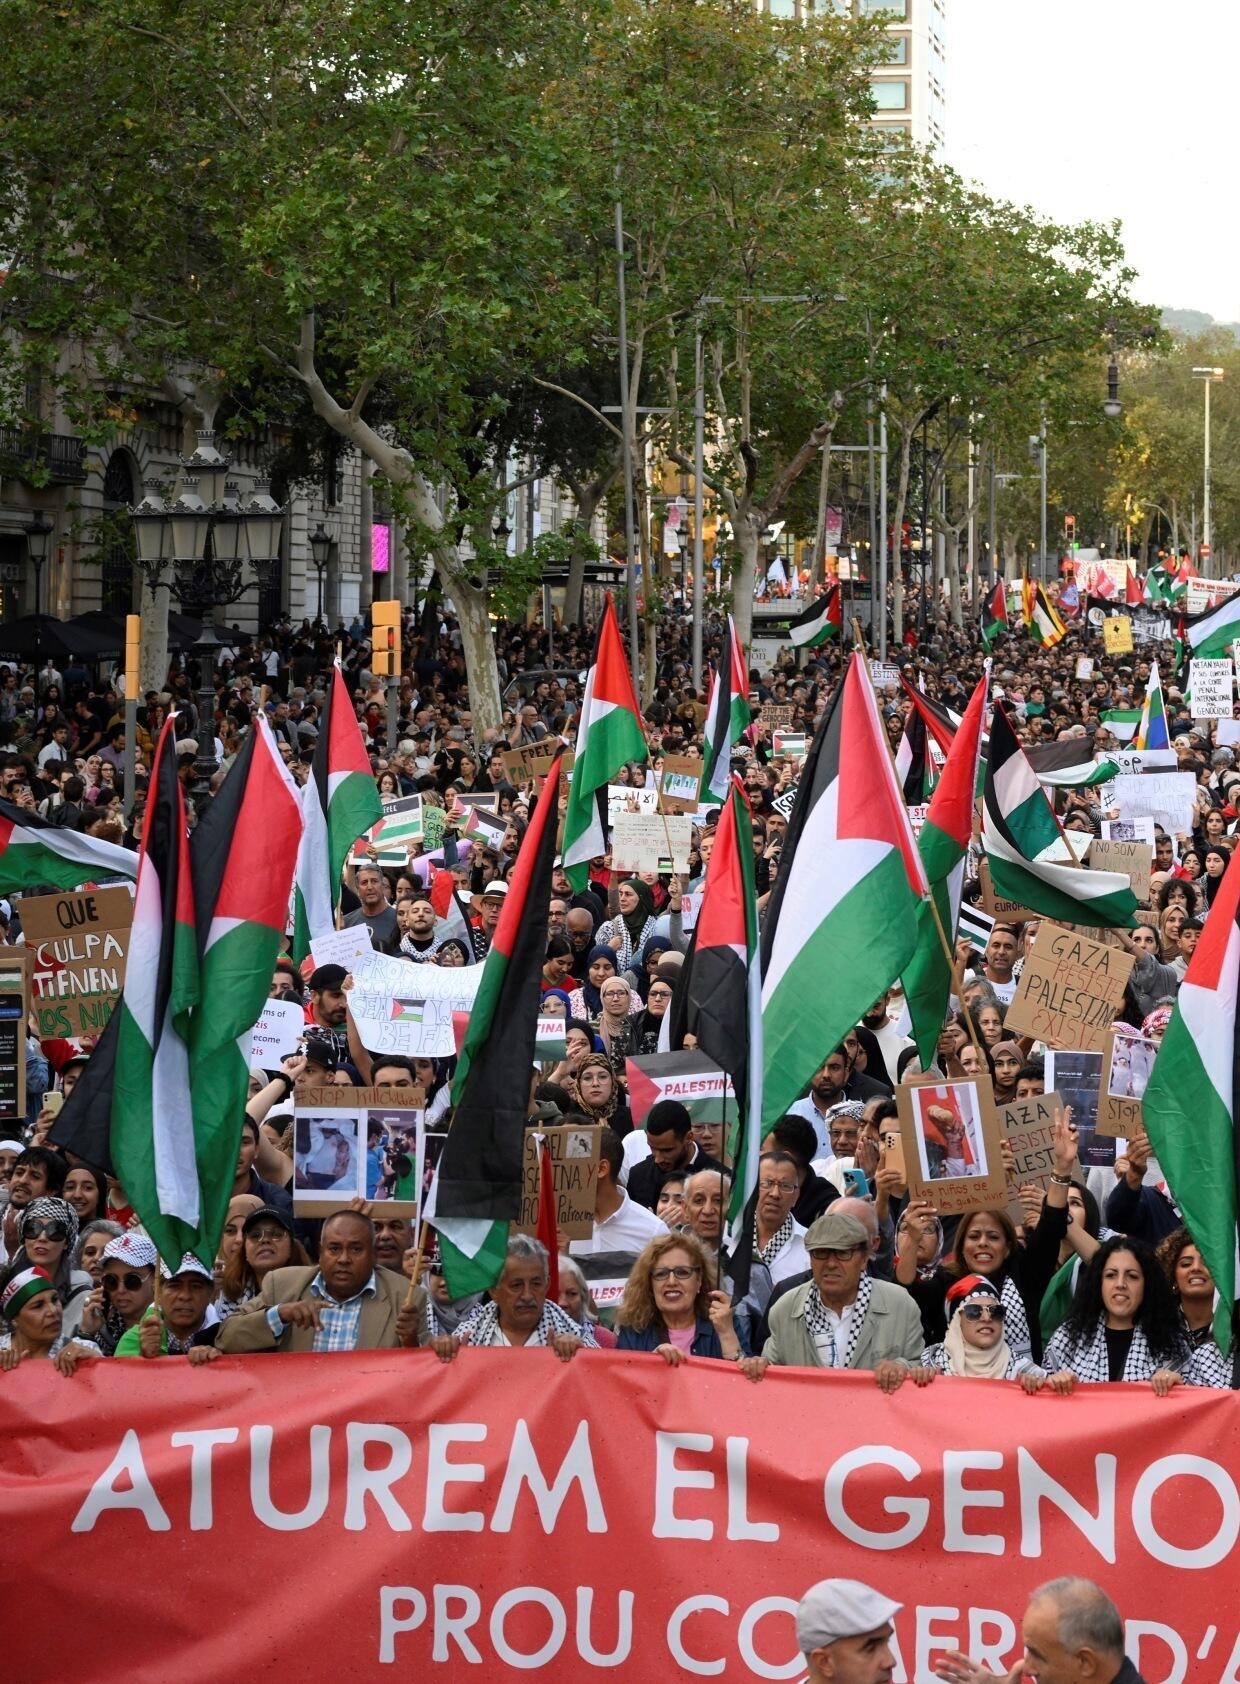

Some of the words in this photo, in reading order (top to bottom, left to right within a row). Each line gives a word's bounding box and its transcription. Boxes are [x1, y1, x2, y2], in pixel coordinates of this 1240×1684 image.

[1193, 661, 1229, 669] NETANYAHU
[762, 706, 776, 714] STOP
[778, 706, 790, 714] THE
[762, 714, 790, 722] GENOCIDE
[1196, 707, 1230, 715] GENOCIDIO
[520, 743, 554, 764] FREE
[1095, 841, 1109, 854] NO
[1113, 843, 1136, 856] SON
[56, 896, 99, 929] QUE
[37, 932, 124, 967] CULPA
[1051, 934, 1110, 975] GAZA
[33, 967, 119, 999] TIENEN
[1053, 960, 1124, 1002] RESISTE
[277, 1008, 286, 1018] of
[350, 996, 389, 1021] SEA
[1024, 974, 1117, 1030] PALESTIN
[38, 1004, 73, 1038] LOS
[1031, 1008, 1102, 1052] EXISTE
[376, 1021, 410, 1053] BE
[416, 1024, 452, 1053] FR
[1014, 1147, 1054, 1175] LEST
[914, 1183, 932, 1198] Los
[938, 1183, 968, 1196] niños
[973, 1181, 988, 1191] de
[984, 1191, 1004, 1201] vivir
[71, 1417, 608, 1535] ATUREM
[652, 1430, 779, 1542] EL
[378, 1585, 634, 1669] PROU
[666, 1594, 1017, 1684] COER
